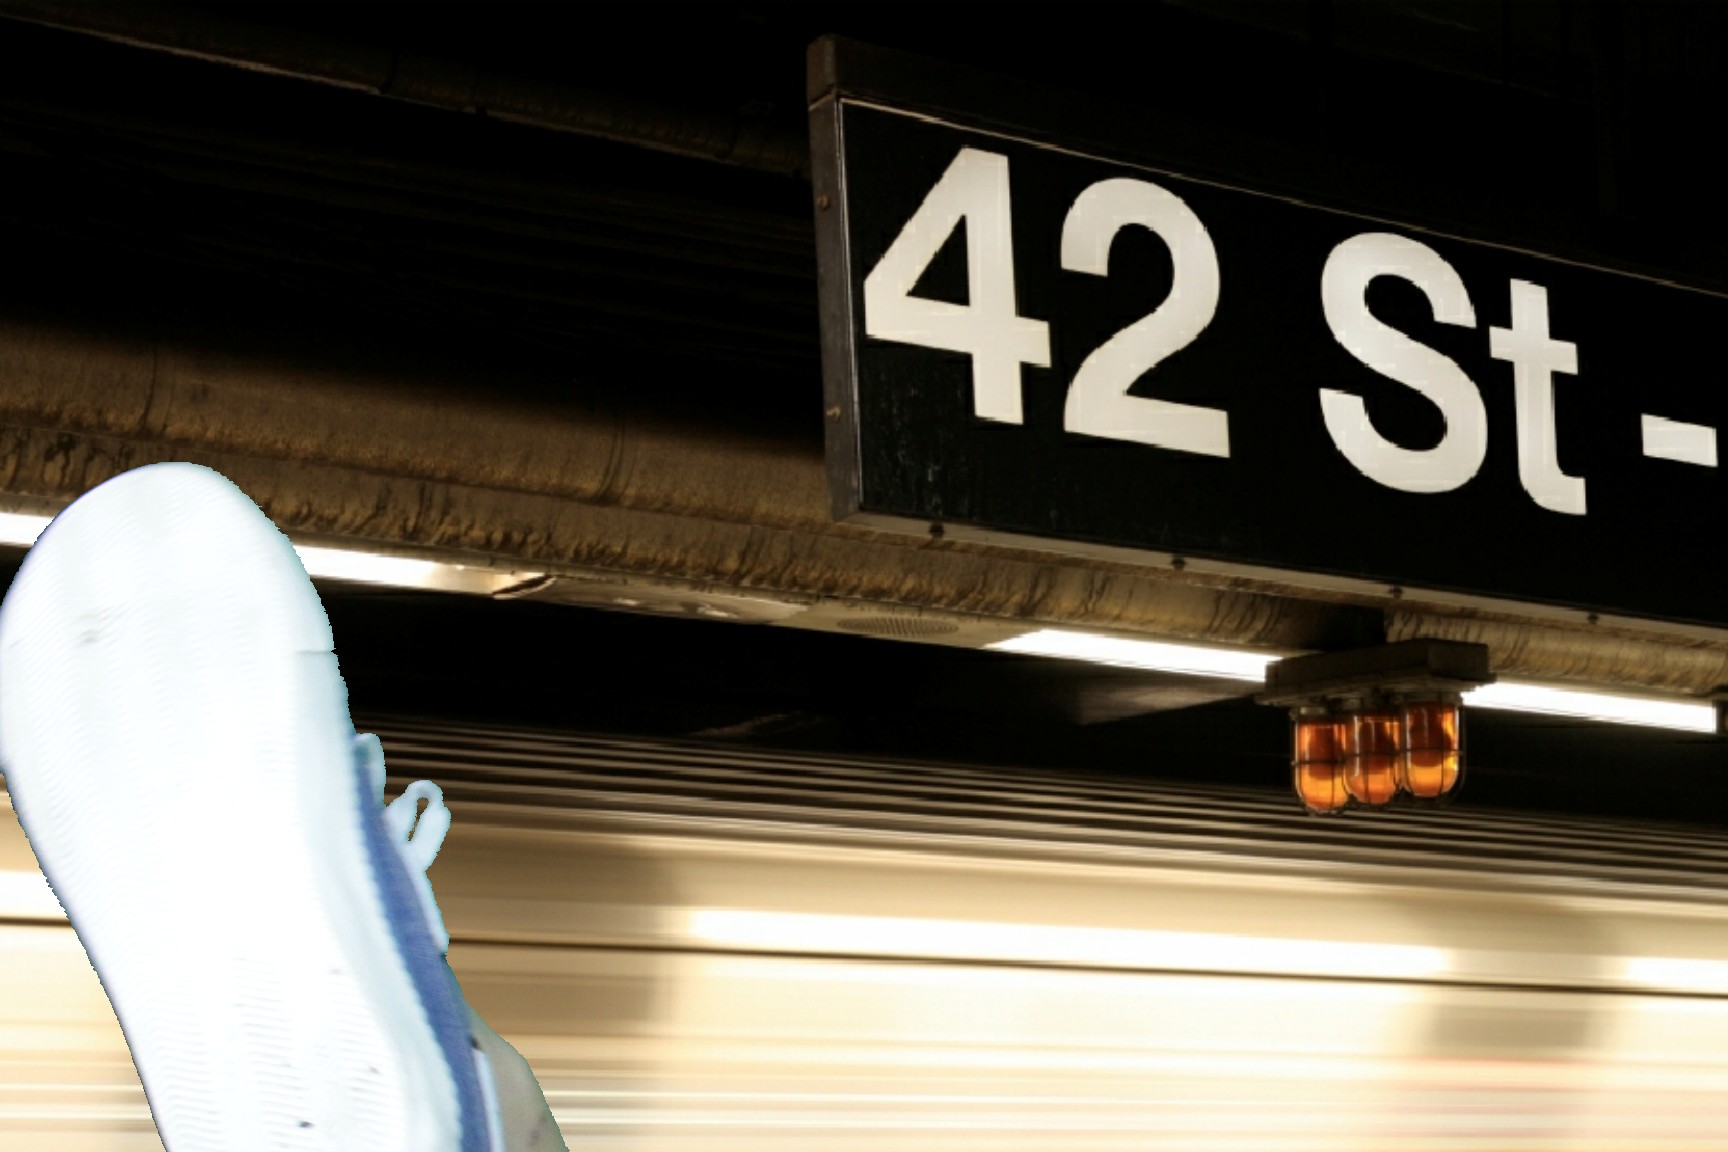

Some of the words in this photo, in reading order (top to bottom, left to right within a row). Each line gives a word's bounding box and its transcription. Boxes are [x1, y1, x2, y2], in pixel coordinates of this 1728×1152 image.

[864, 147, 1230, 458] 42
[1319, 232, 1587, 515] St
[1641, 414, 1718, 467] -
